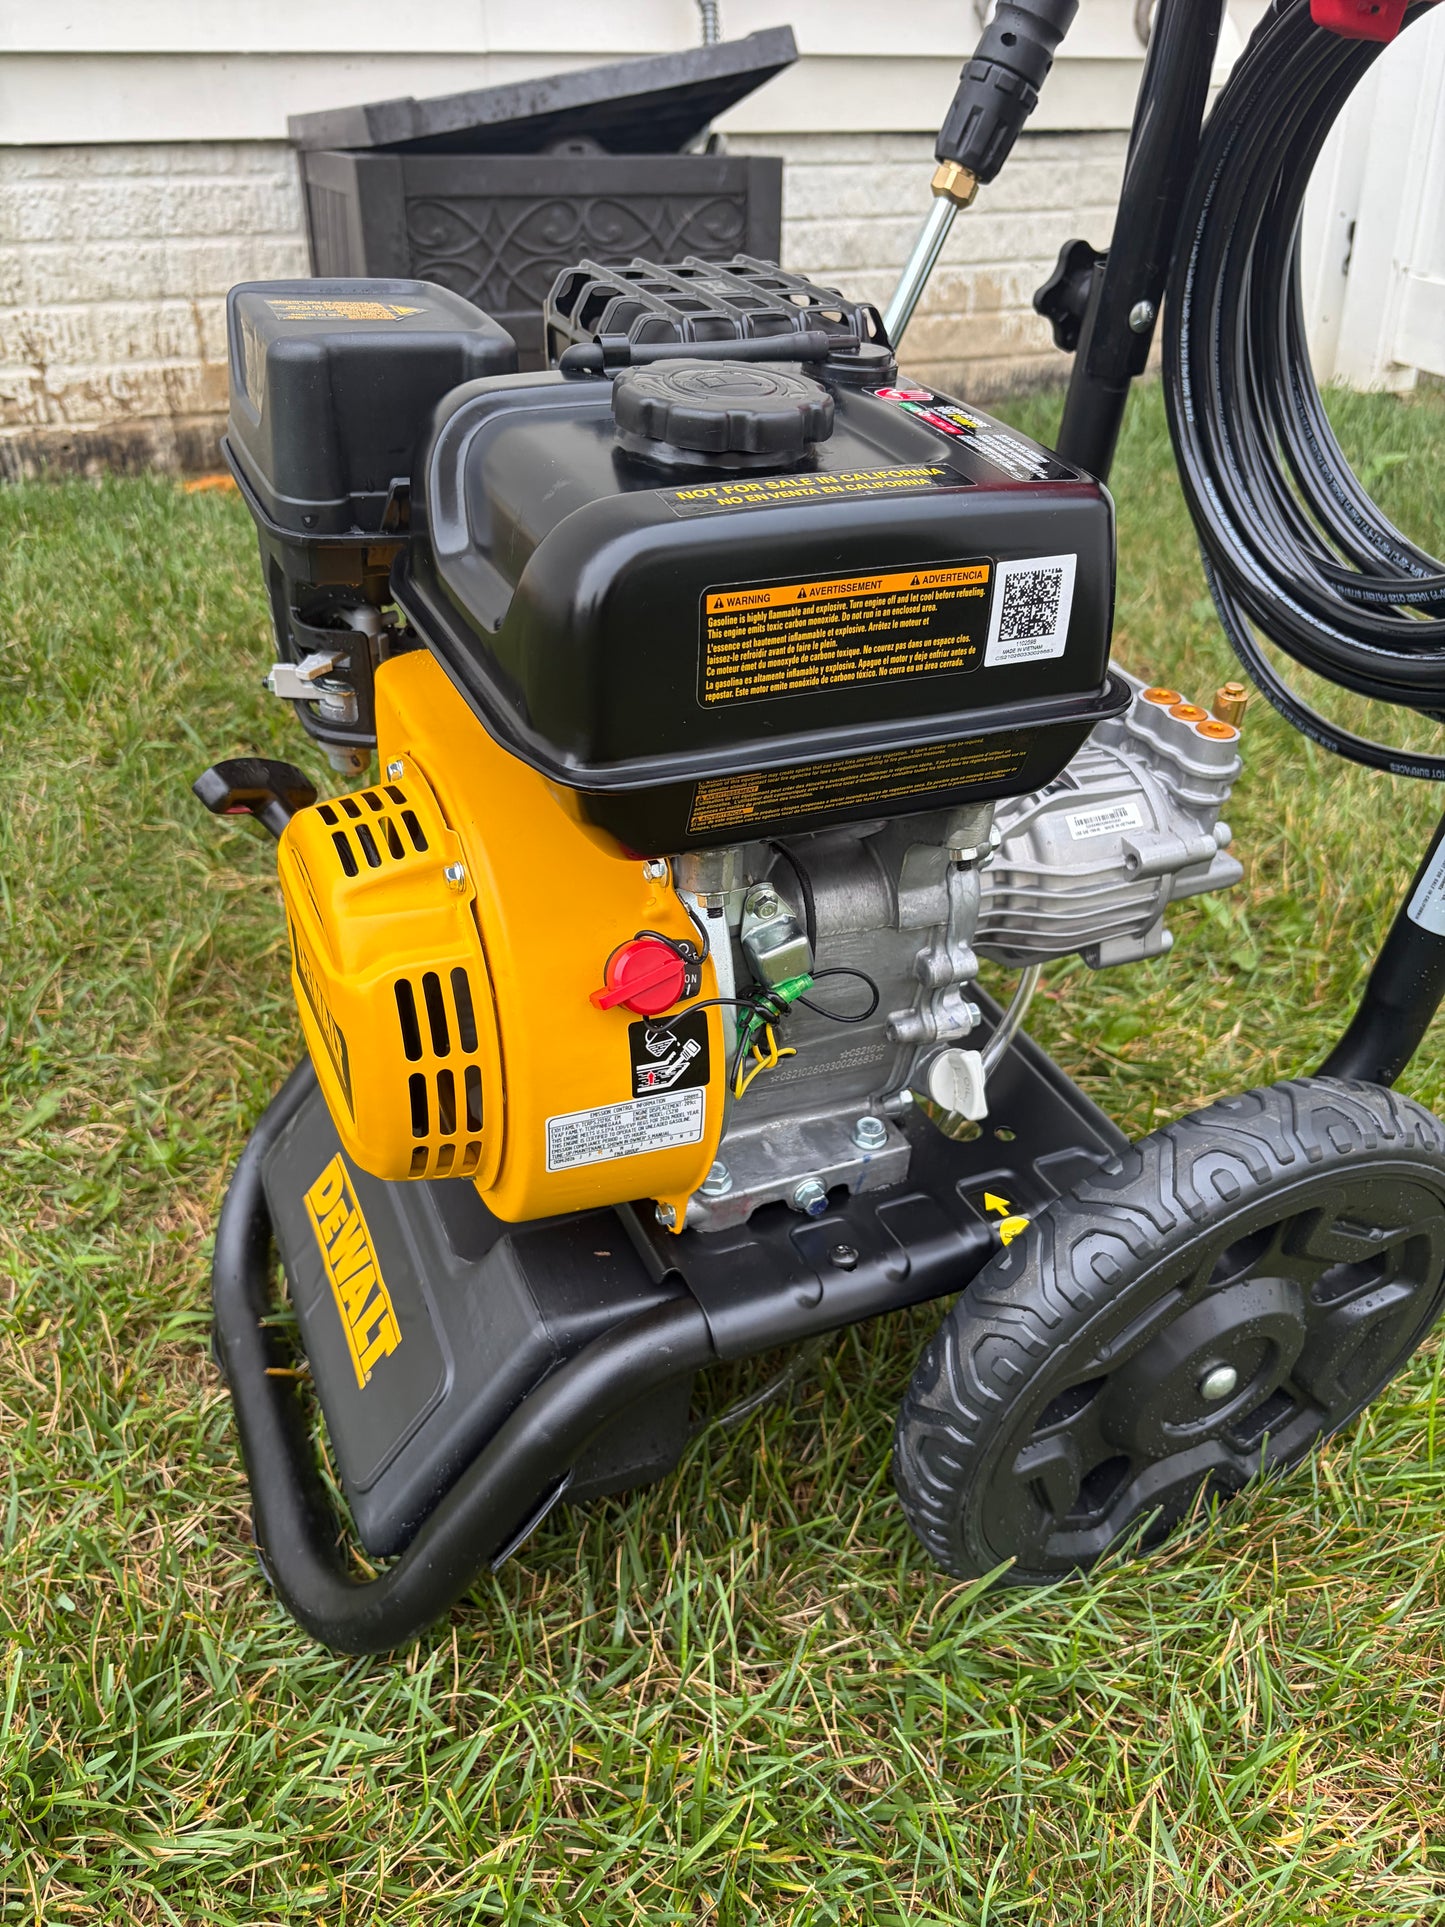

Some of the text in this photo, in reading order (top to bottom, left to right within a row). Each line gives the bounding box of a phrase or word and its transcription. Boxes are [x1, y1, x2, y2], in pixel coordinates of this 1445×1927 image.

[676, 467, 946, 500] NOT FOR SALE IN CALIFORNIA
[717, 478, 931, 506] NO EN VENTA EN CALIFORNIA
[809, 580, 882, 596] AVERTISSEMENT
[922, 571, 982, 584] ADVERTENCIA
[708, 617, 737, 627] Gasoline
[740, 614, 745, 623] is
[747, 612, 767, 624] highly
[768, 607, 801, 620] flammable
[803, 604, 814, 615] and
[816, 600, 848, 616] explosive.
[850, 599, 863, 609] Turn
[865, 597, 885, 608] engine
[897, 594, 908, 604] and
[910, 593, 918, 602] let
[920, 592, 934, 601] cool
[935, 590, 955, 600] before
[956, 587, 985, 598] refueling.
[727, 594, 770, 606] WARNING
[708, 604, 937, 639] This engine emits toxic carbon monoxide. Do not run in an enclosed area.
[708, 617, 929, 653] L'essence est hautement inflammable et explosive. Arrêtez le moteur et
[706, 634, 970, 676] Ce moteur émet du monoxyde de carbone toxique. Ne courez pas dans un espace clos.
[706, 681, 713, 690] La
[715, 677, 743, 691] gasolina
[754, 670, 785, 683] altamente
[786, 666, 818, 679] inflamable
[820, 665, 824, 675] y
[825, 660, 857, 675] explosiva.
[858, 659, 881, 669] Apague
[883, 656, 889, 665] el
[890, 654, 907, 664] motor
[909, 654, 913, 663] y
[914, 652, 927, 662] deje
[929, 648, 949, 658] enfriar
[951, 648, 967, 656] antes
[969, 646, 976, 654] de
[707, 639, 837, 665] laissez-le refroidir avant de faire le plein.
[705, 691, 733, 702] repostar.
[735, 688, 749, 697] Este
[750, 685, 768, 694] motor
[770, 681, 787, 691] emite
[789, 677, 819, 689] monóxido
[821, 676, 828, 685] de
[830, 672, 855, 684] carbono
[857, 668, 877, 679] tóxico.
[879, 667, 887, 676] No
[889, 664, 905, 674] corra
[924, 660, 938, 669] área
[939, 658, 964, 668] cerrada.
[685, 974, 697, 983] ON
[590, 1099, 666, 1118] EMISSION CONTROL INFORMATION
[307, 1156, 401, 1377] DEWALT
